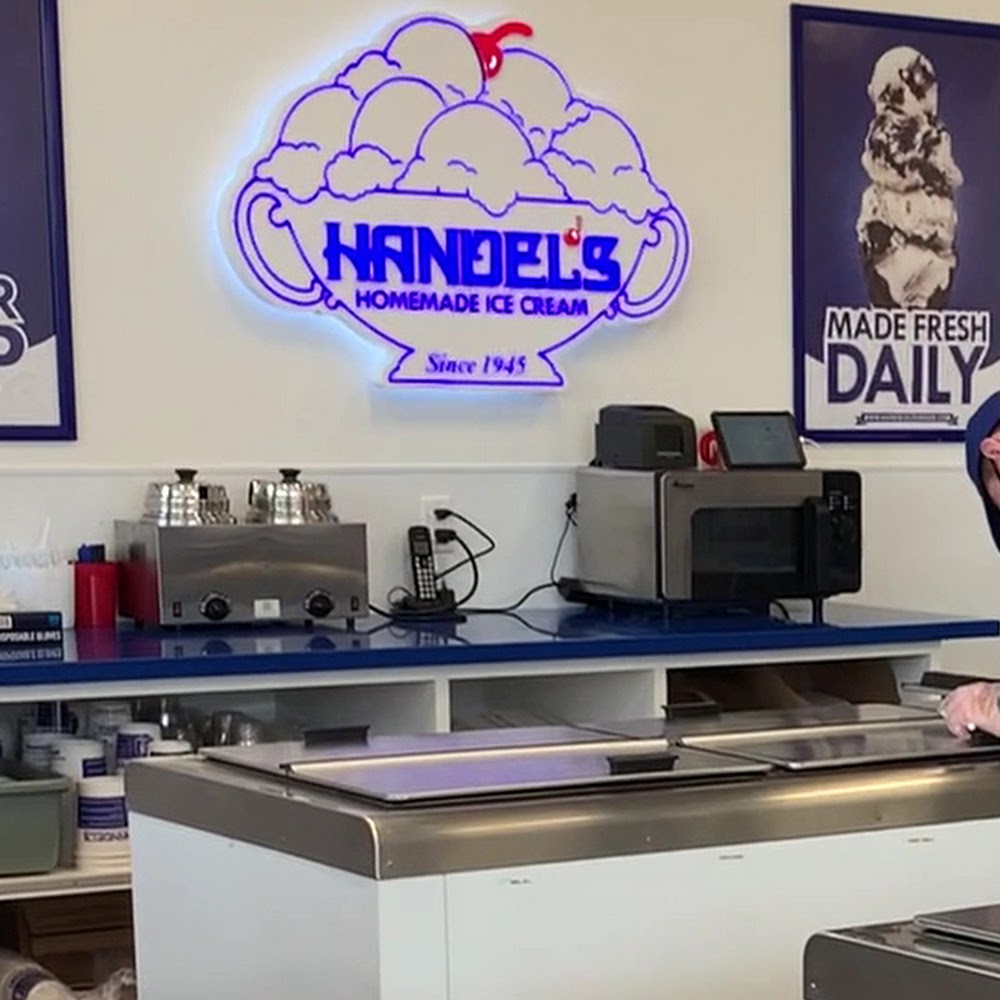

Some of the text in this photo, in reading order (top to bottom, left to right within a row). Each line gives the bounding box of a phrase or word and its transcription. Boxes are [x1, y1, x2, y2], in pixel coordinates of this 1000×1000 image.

[323, 221, 621, 292] HANDEL'S
[355, 289, 589, 316] HOMEMADE ICE CREAM
[827, 310, 987, 343] MADE FRESH
[425, 352, 527, 375] Since 1945
[826, 342, 985, 405] DAILY
